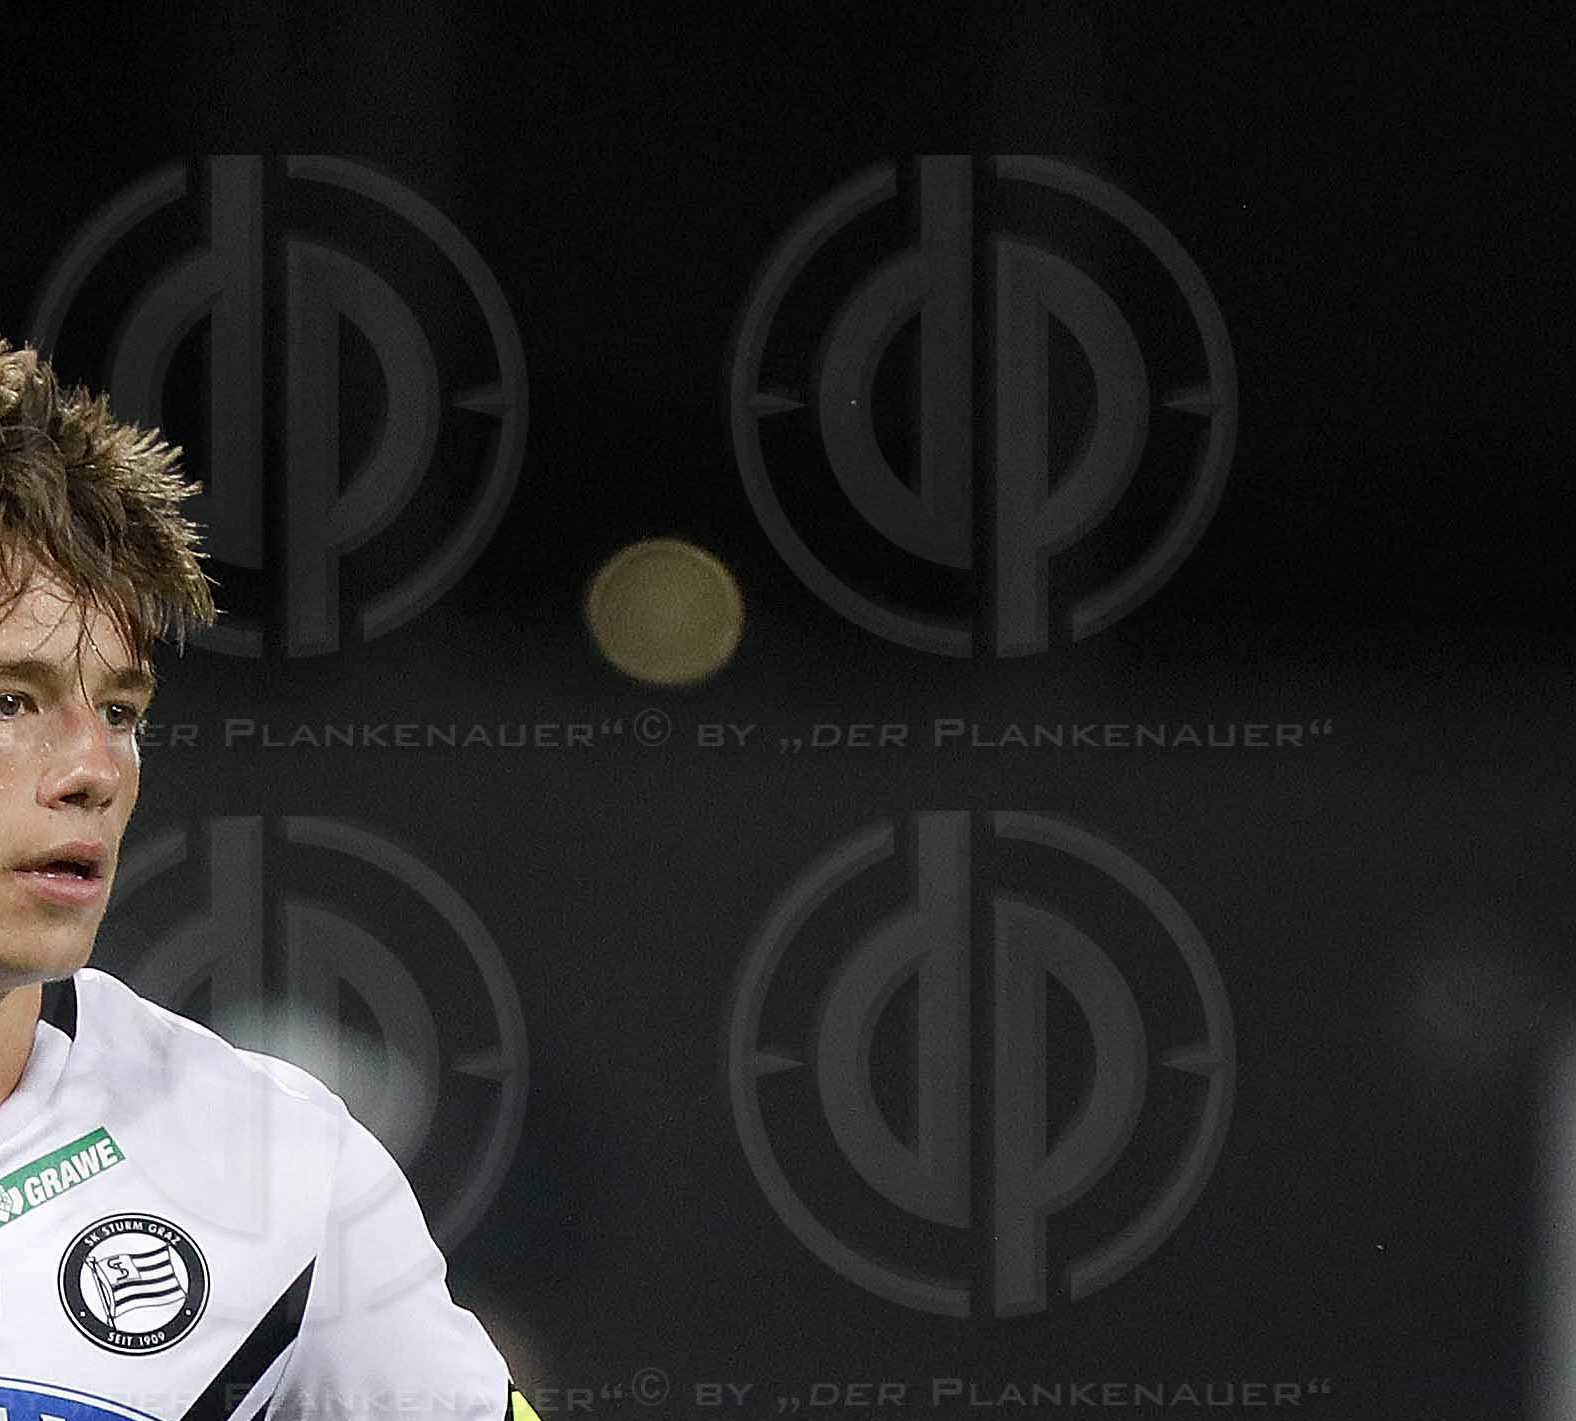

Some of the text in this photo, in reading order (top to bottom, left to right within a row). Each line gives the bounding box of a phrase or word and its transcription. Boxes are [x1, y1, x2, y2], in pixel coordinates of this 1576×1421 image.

[23, 1137, 119, 1207] GRAWE
[83, 1220, 182, 1247] SK STURM GRAZ
[107, 1331, 166, 1347] SEIT 1909
